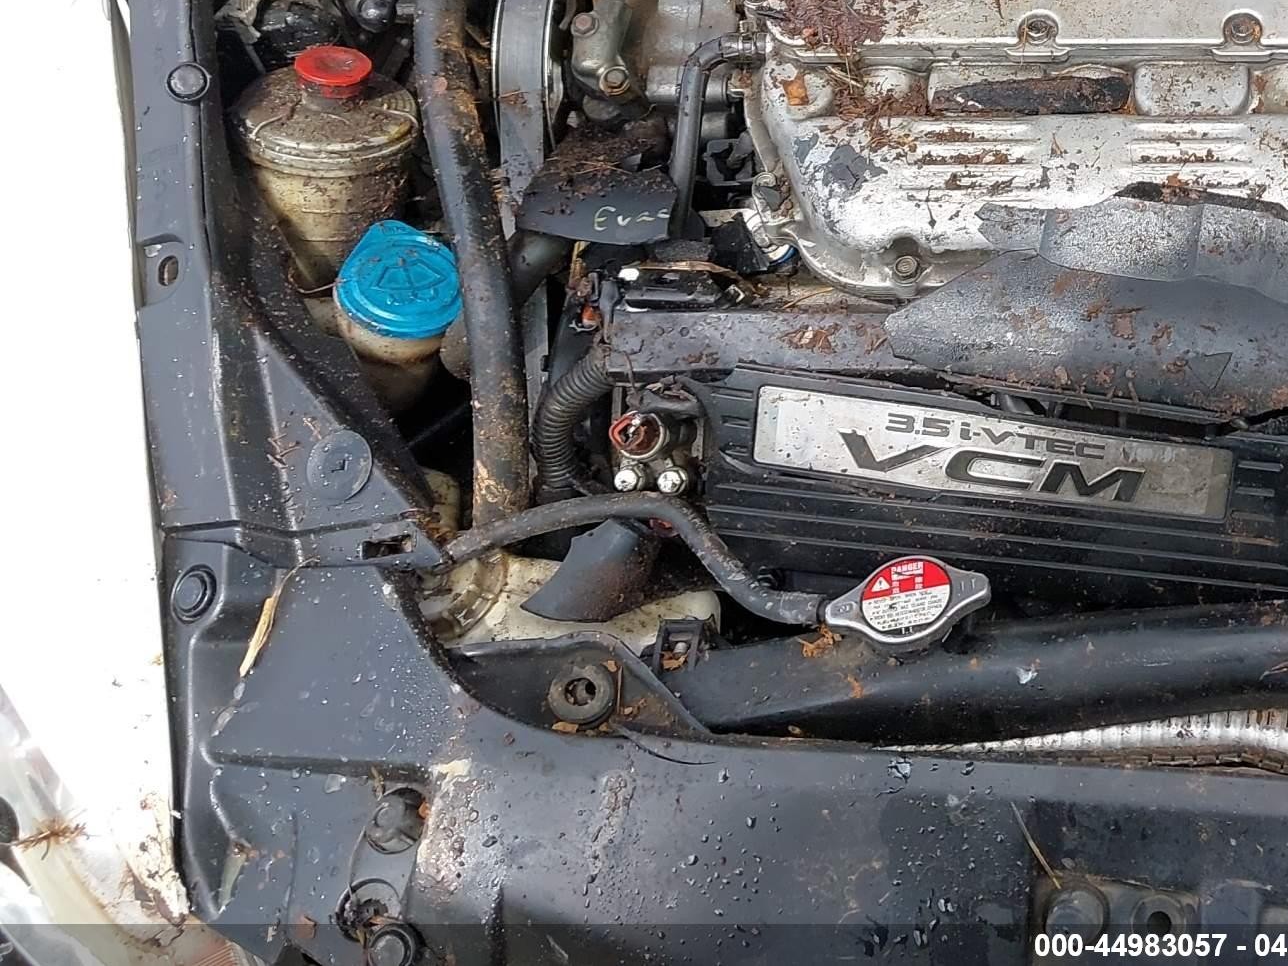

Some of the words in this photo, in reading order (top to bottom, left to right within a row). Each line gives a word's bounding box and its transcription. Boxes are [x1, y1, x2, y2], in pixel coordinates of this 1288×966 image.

[838, 428, 1146, 502] VCM
[885, 413, 953, 439] 3.5
[960, 422, 1107, 460] i-VTEC
